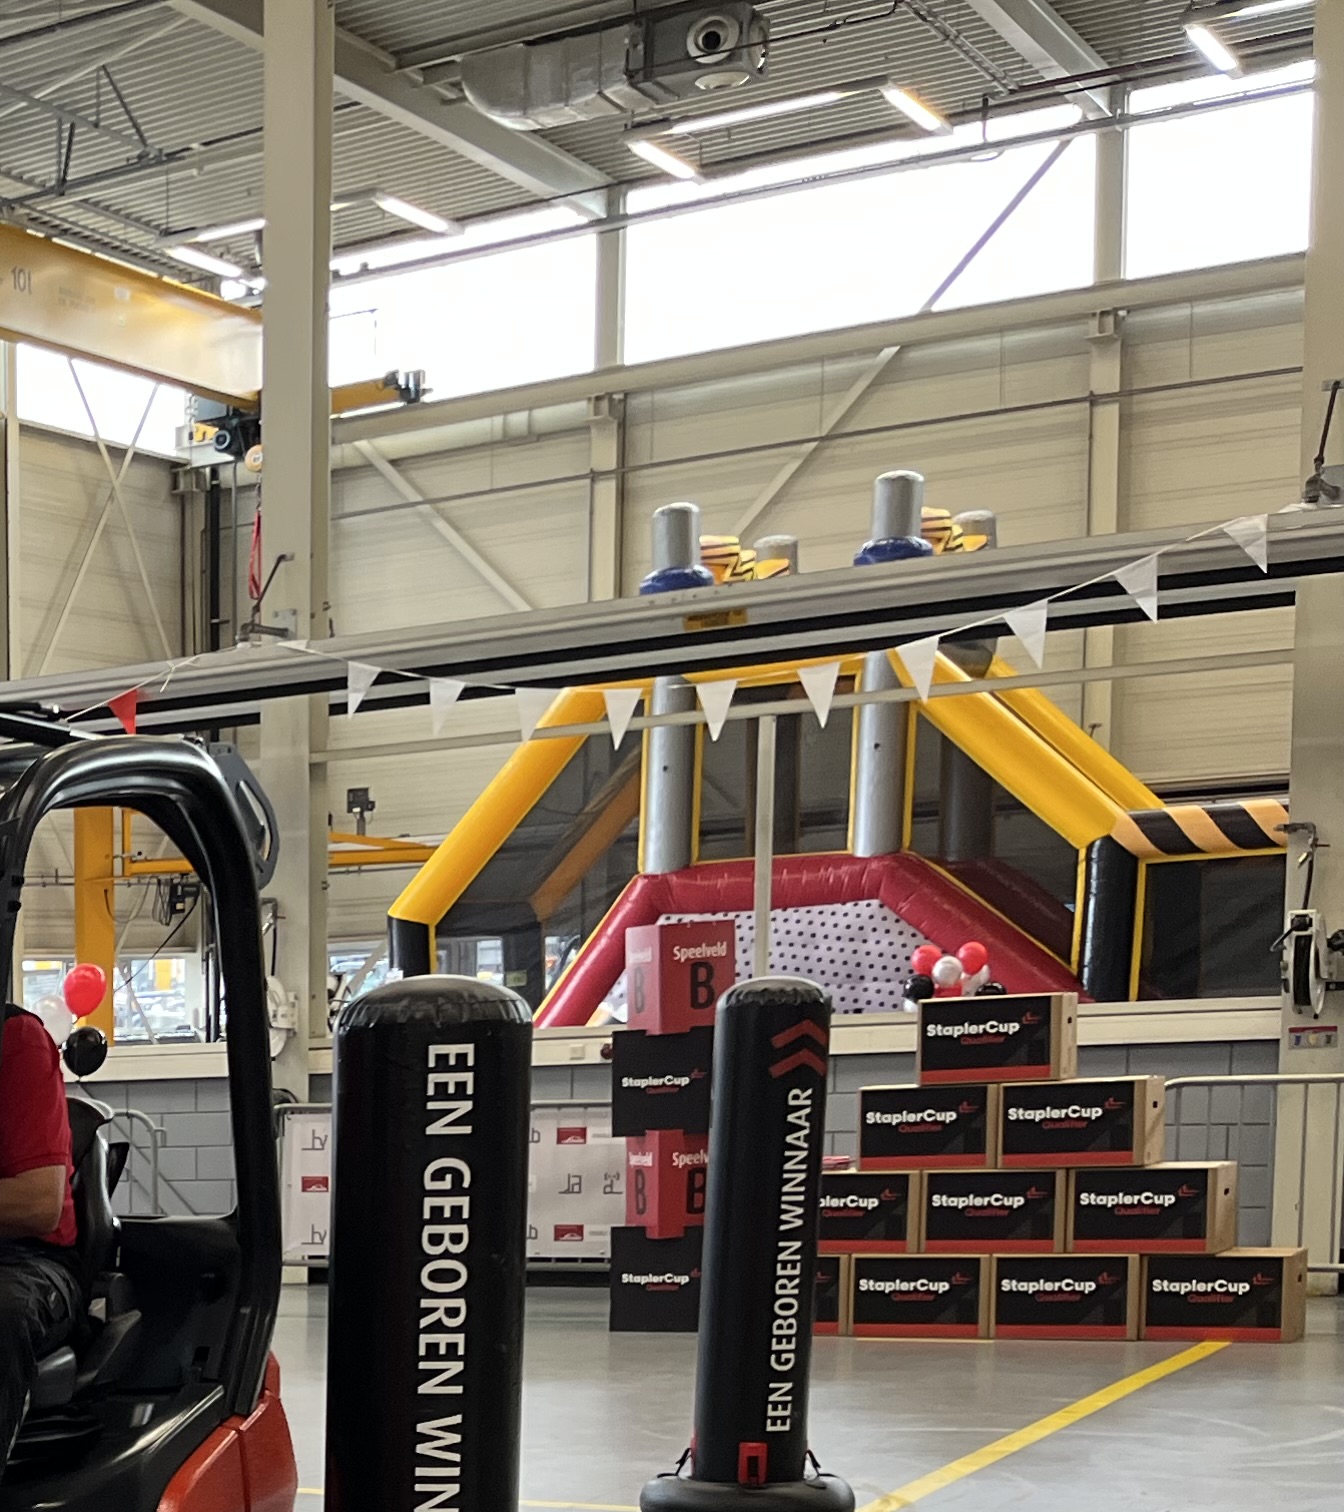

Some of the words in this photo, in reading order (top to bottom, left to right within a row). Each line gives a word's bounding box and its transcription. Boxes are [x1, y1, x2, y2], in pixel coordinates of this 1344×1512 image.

[673, 941, 727, 963] Speelveld
[690, 961, 715, 1010] B
[926, 1020, 1020, 1038] StaplerCup
[425, 1043, 475, 1135] EEN
[621, 1075, 690, 1088] StaplerCup
[865, 1108, 957, 1125] StaplerCup
[1008, 1105, 1103, 1122] StaplerCup
[672, 1150, 709, 1168] Speelv
[778, 1087, 813, 1231] WINNAAR
[687, 1167, 707, 1214] B
[1080, 1192, 1176, 1207] StaplerCup
[932, 1194, 1025, 1209] StaplerCup
[417, 1157, 471, 1394] GEBOREN
[621, 1273, 690, 1285] StaplerCup
[859, 1279, 950, 1294] StaplerCup
[1001, 1279, 1097, 1294] StaplerCup
[1152, 1279, 1251, 1295] StaplerCup
[770, 1240, 803, 1372] GEBOREN
[766, 1382, 794, 1432] EEN
